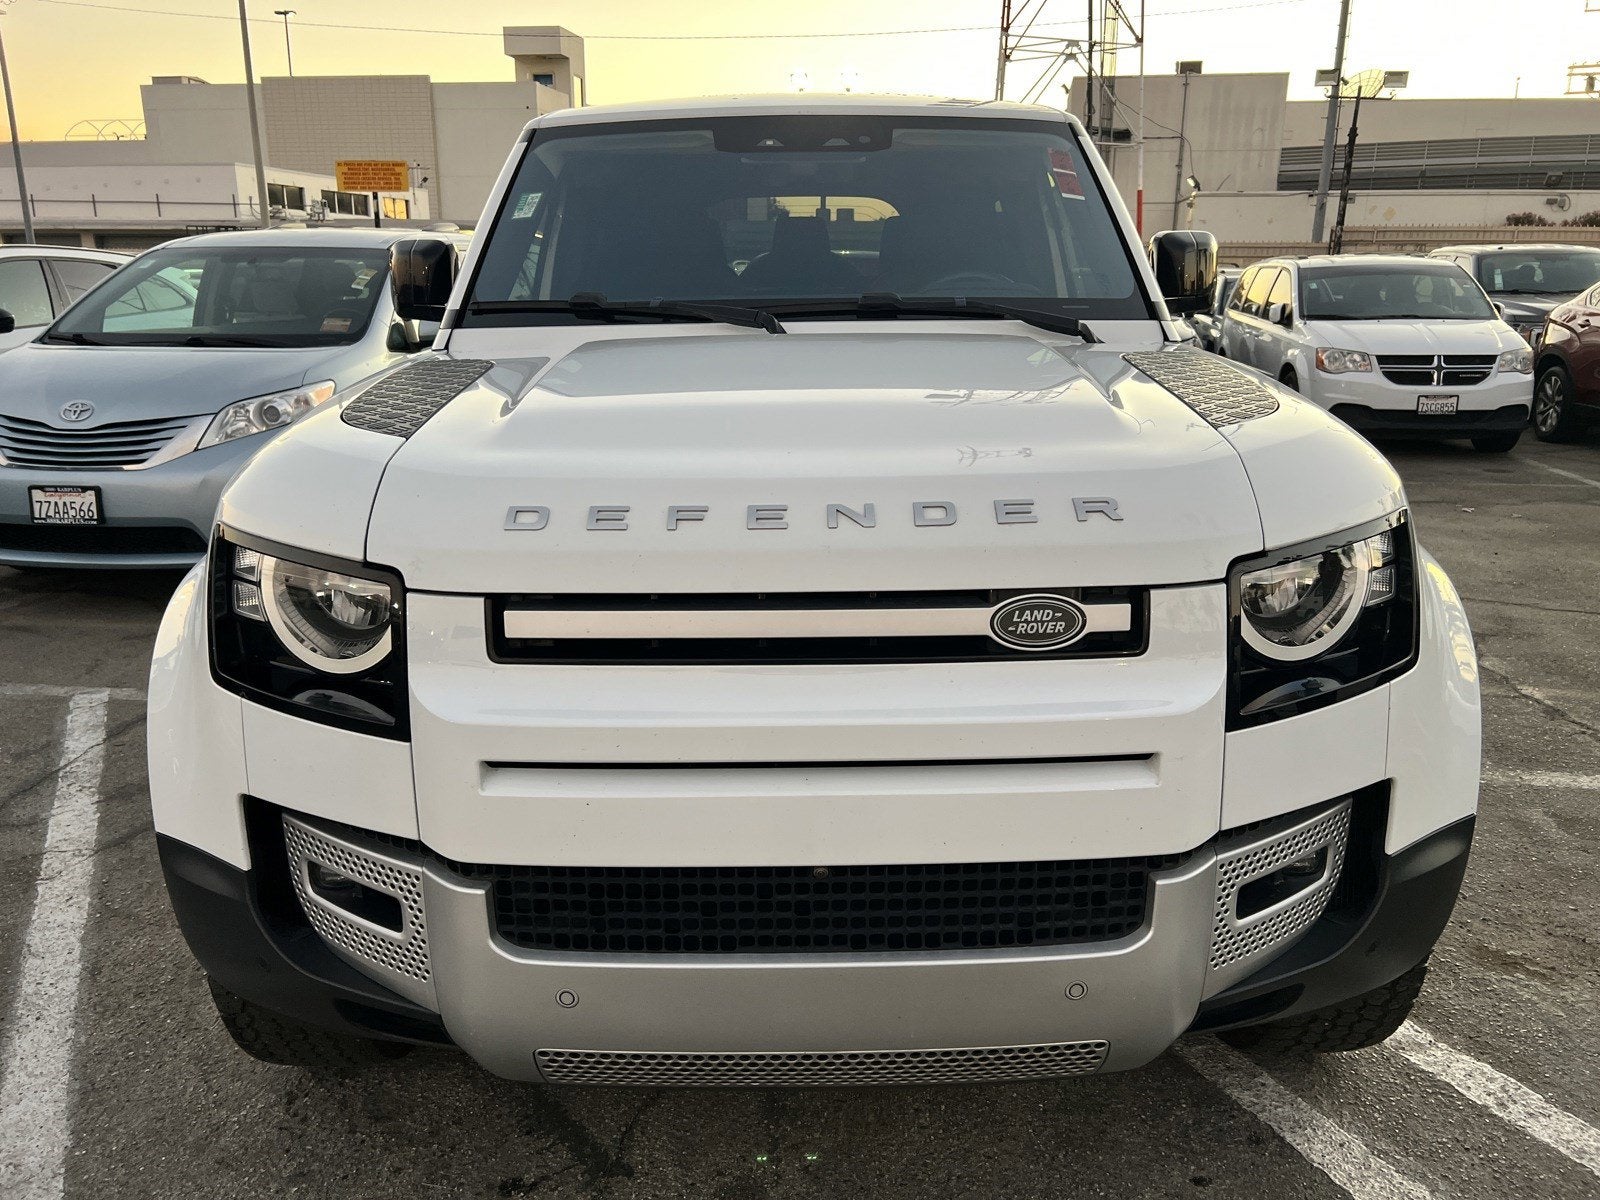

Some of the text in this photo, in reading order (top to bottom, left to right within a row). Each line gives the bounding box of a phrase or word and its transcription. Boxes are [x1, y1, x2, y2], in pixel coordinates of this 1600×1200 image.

[35, 500, 95, 519] 7ZAA566
[503, 496, 1125, 531] DEFENDER
[1013, 609, 1053, 622] LAND
[1016, 621, 1066, 634] ROVER
